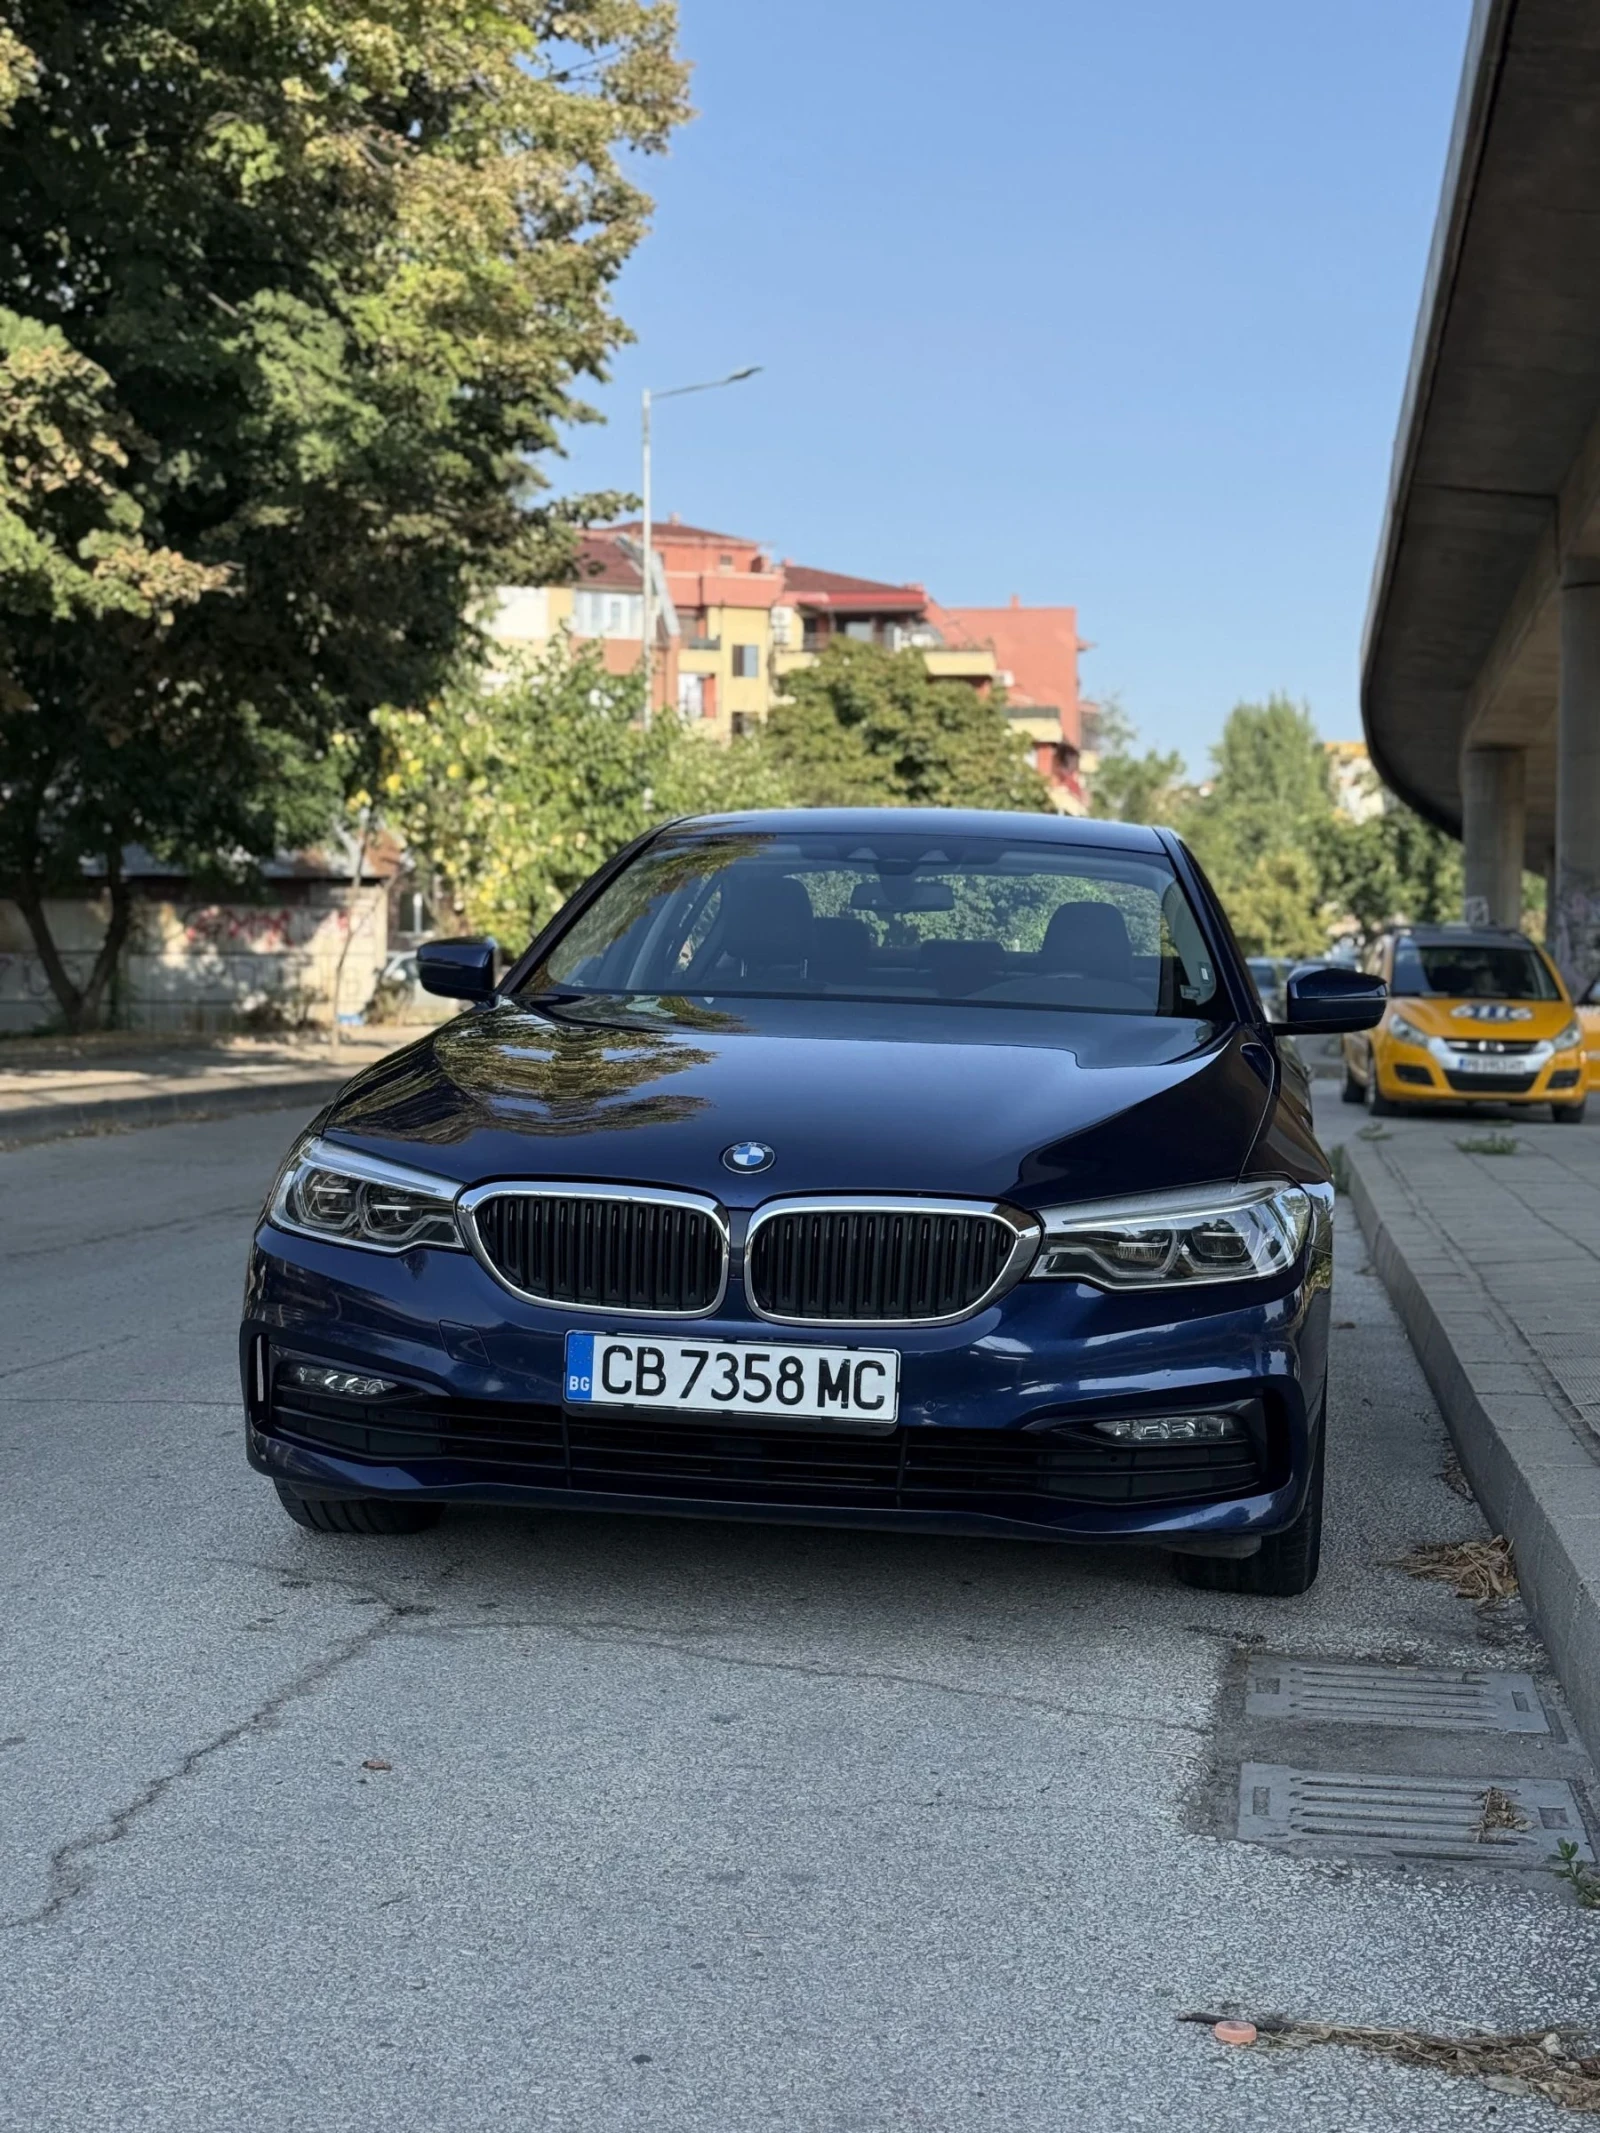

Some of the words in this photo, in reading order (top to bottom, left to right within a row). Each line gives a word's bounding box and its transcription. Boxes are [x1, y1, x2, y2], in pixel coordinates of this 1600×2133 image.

[568, 1376, 590, 1392] BG
[602, 1345, 666, 1397] CB
[679, 1349, 804, 1406] 7358
[817, 1357, 886, 1410] MC
